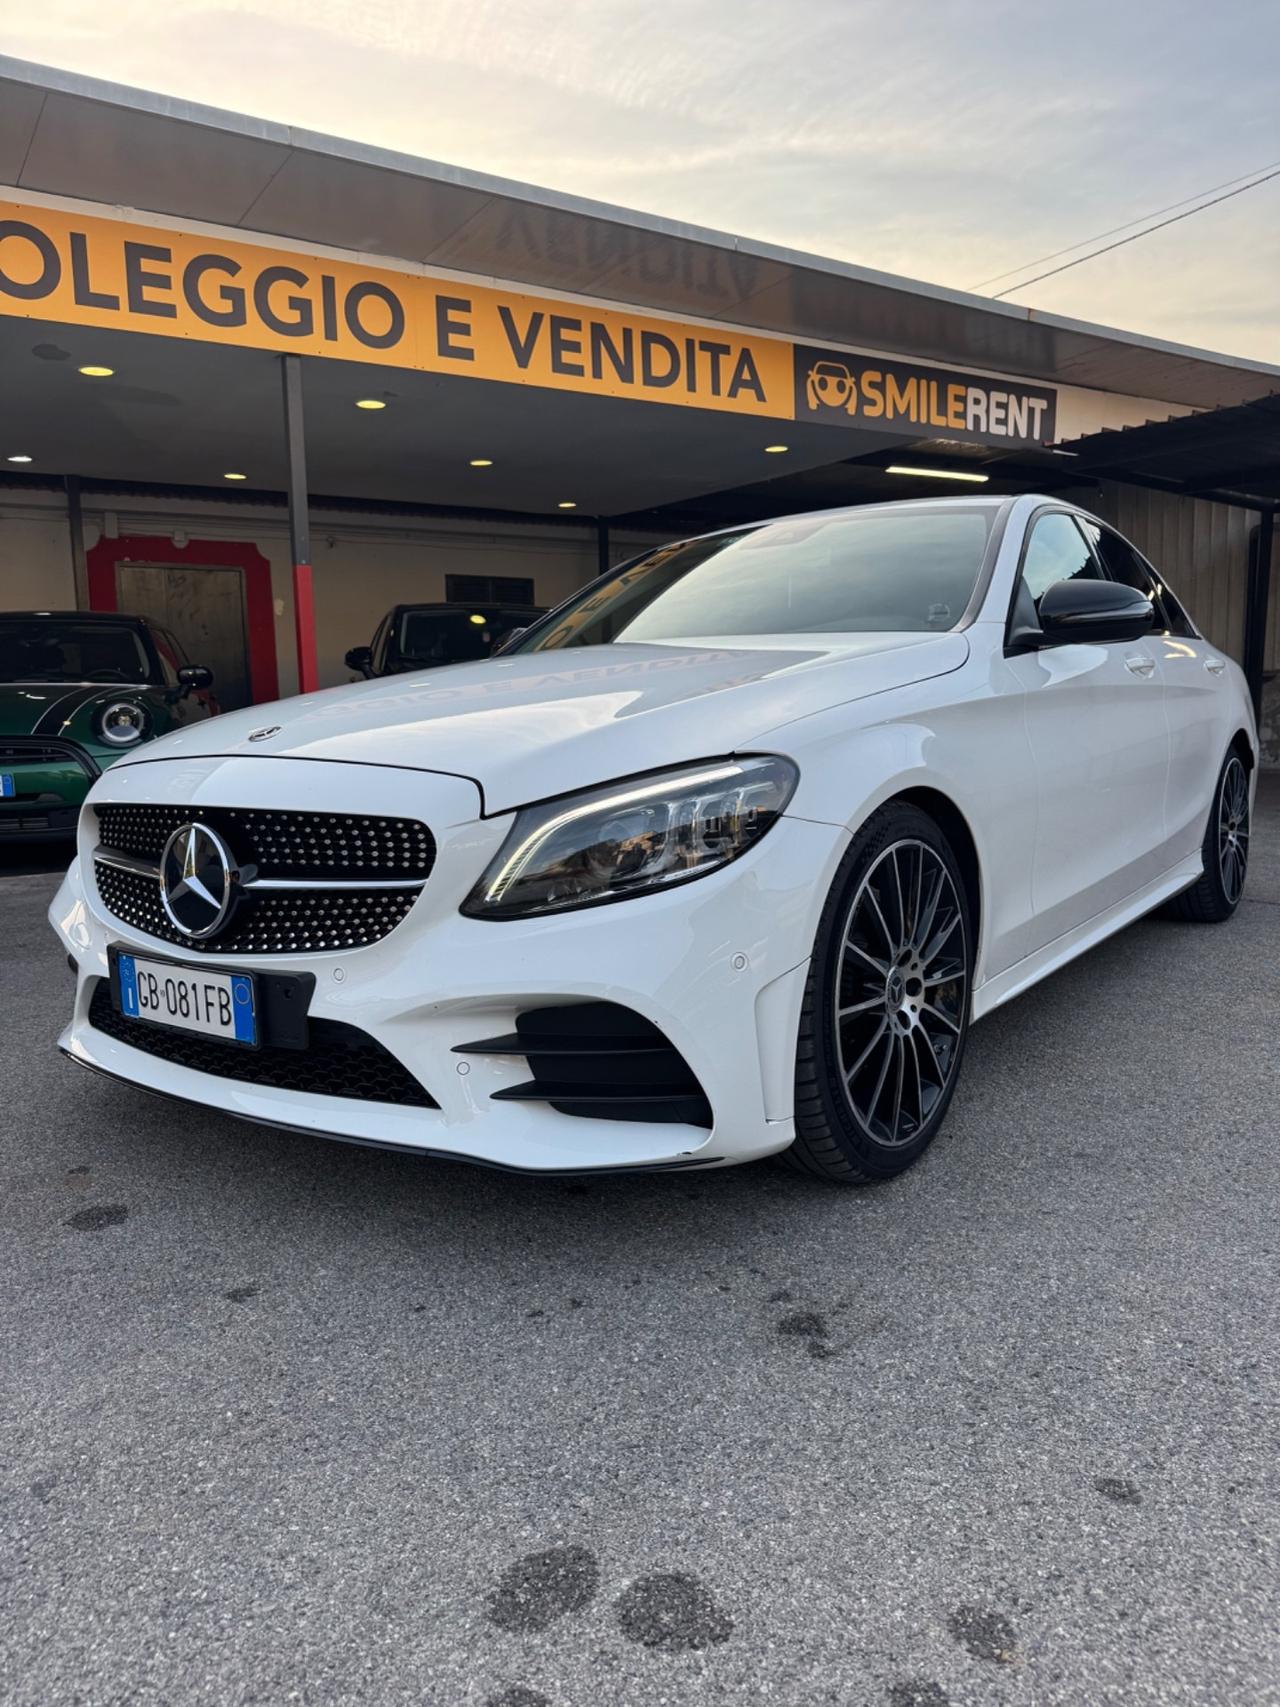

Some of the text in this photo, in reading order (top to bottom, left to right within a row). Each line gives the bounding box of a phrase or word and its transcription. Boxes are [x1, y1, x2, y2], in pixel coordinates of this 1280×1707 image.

[0, 220, 405, 349] OLEGGIO
[436, 295, 475, 361] E
[497, 305, 767, 403] VENDITA
[860, 370, 1048, 441] SMILERENT
